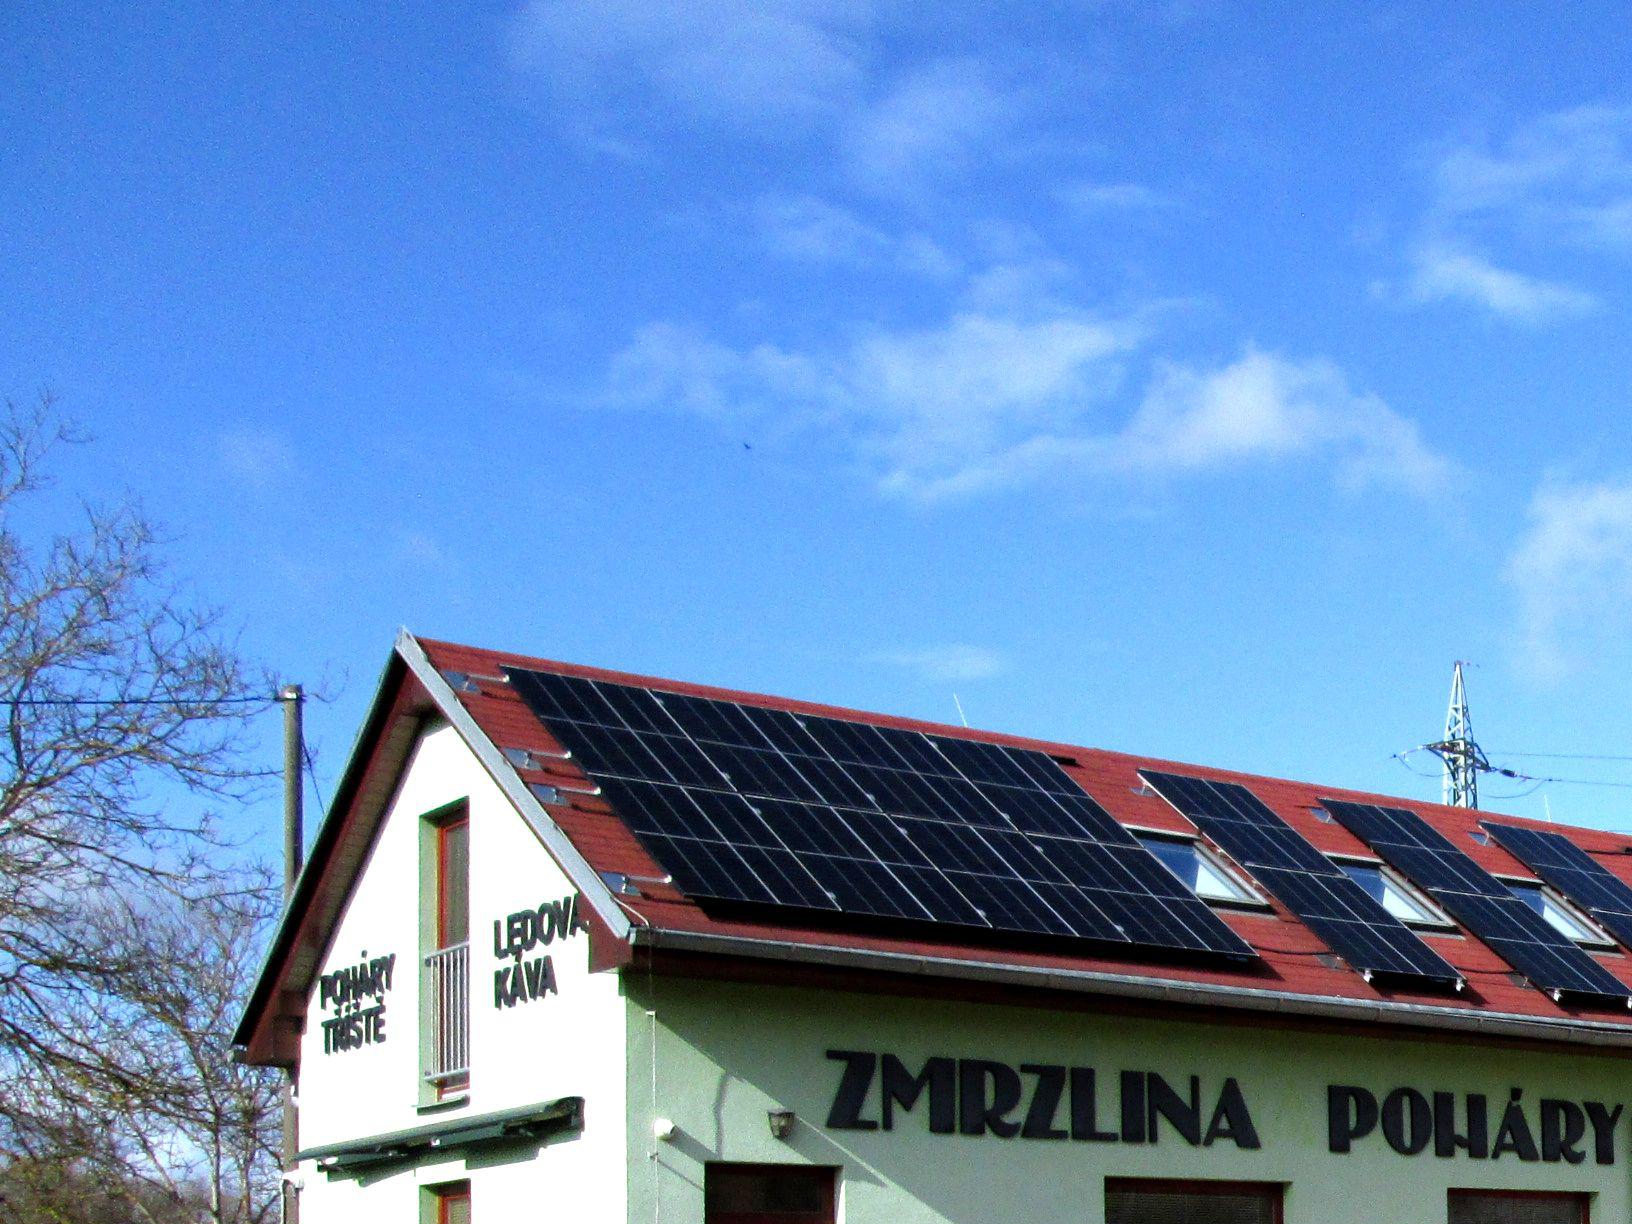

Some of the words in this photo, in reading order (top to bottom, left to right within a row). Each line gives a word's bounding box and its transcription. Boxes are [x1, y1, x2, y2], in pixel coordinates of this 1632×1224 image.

[320, 950, 396, 1009] POHÁRY
[494, 951, 558, 1010] KÁVA
[825, 1049, 1261, 1149] ZMRZLINA
[1327, 1085, 1623, 1165] POHÁRY
